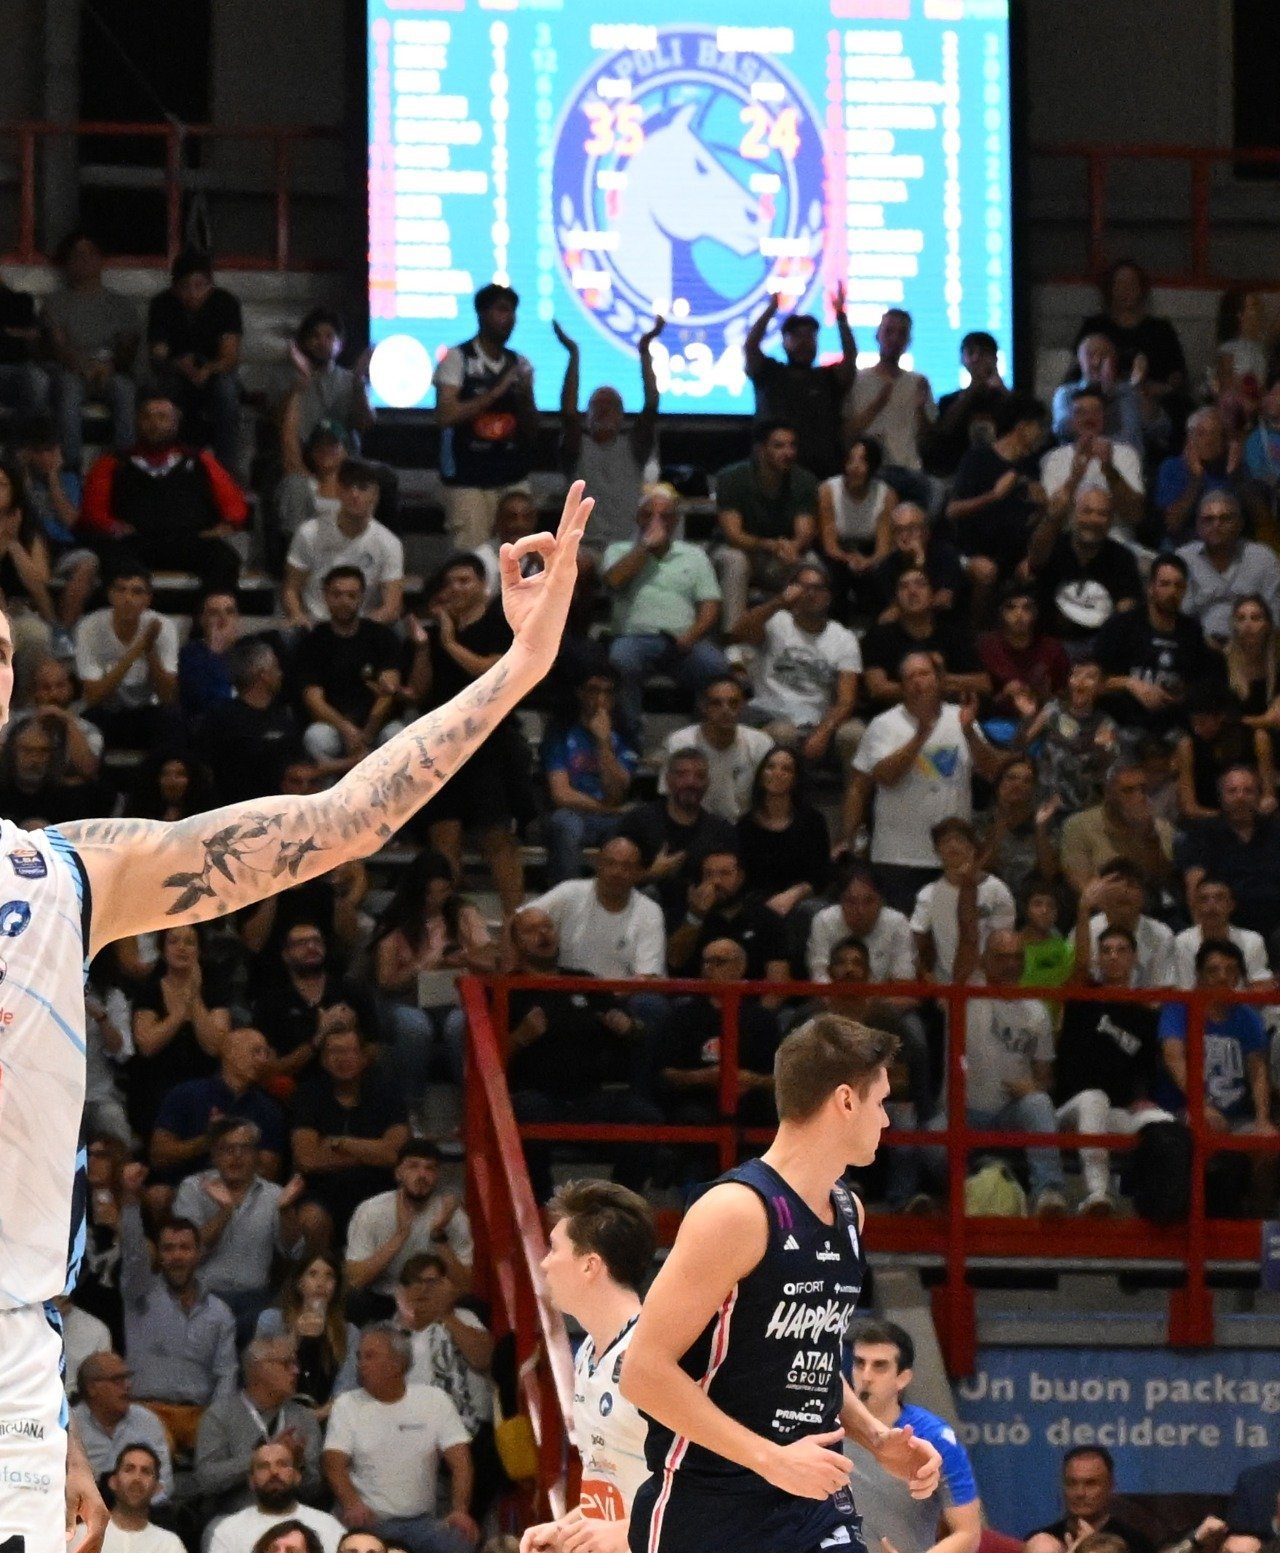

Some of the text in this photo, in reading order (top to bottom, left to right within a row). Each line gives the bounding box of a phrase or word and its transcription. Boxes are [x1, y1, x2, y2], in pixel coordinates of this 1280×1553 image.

[584, 102, 646, 157] 35
[739, 105, 801, 160] 24
[773, 1196, 794, 1230] 11
[1029, 1371, 1133, 1402] buon
[1046, 1417, 1221, 1448] decidere
[1235, 1415, 1269, 1448] la
[579, 1486, 617, 1521] evi
